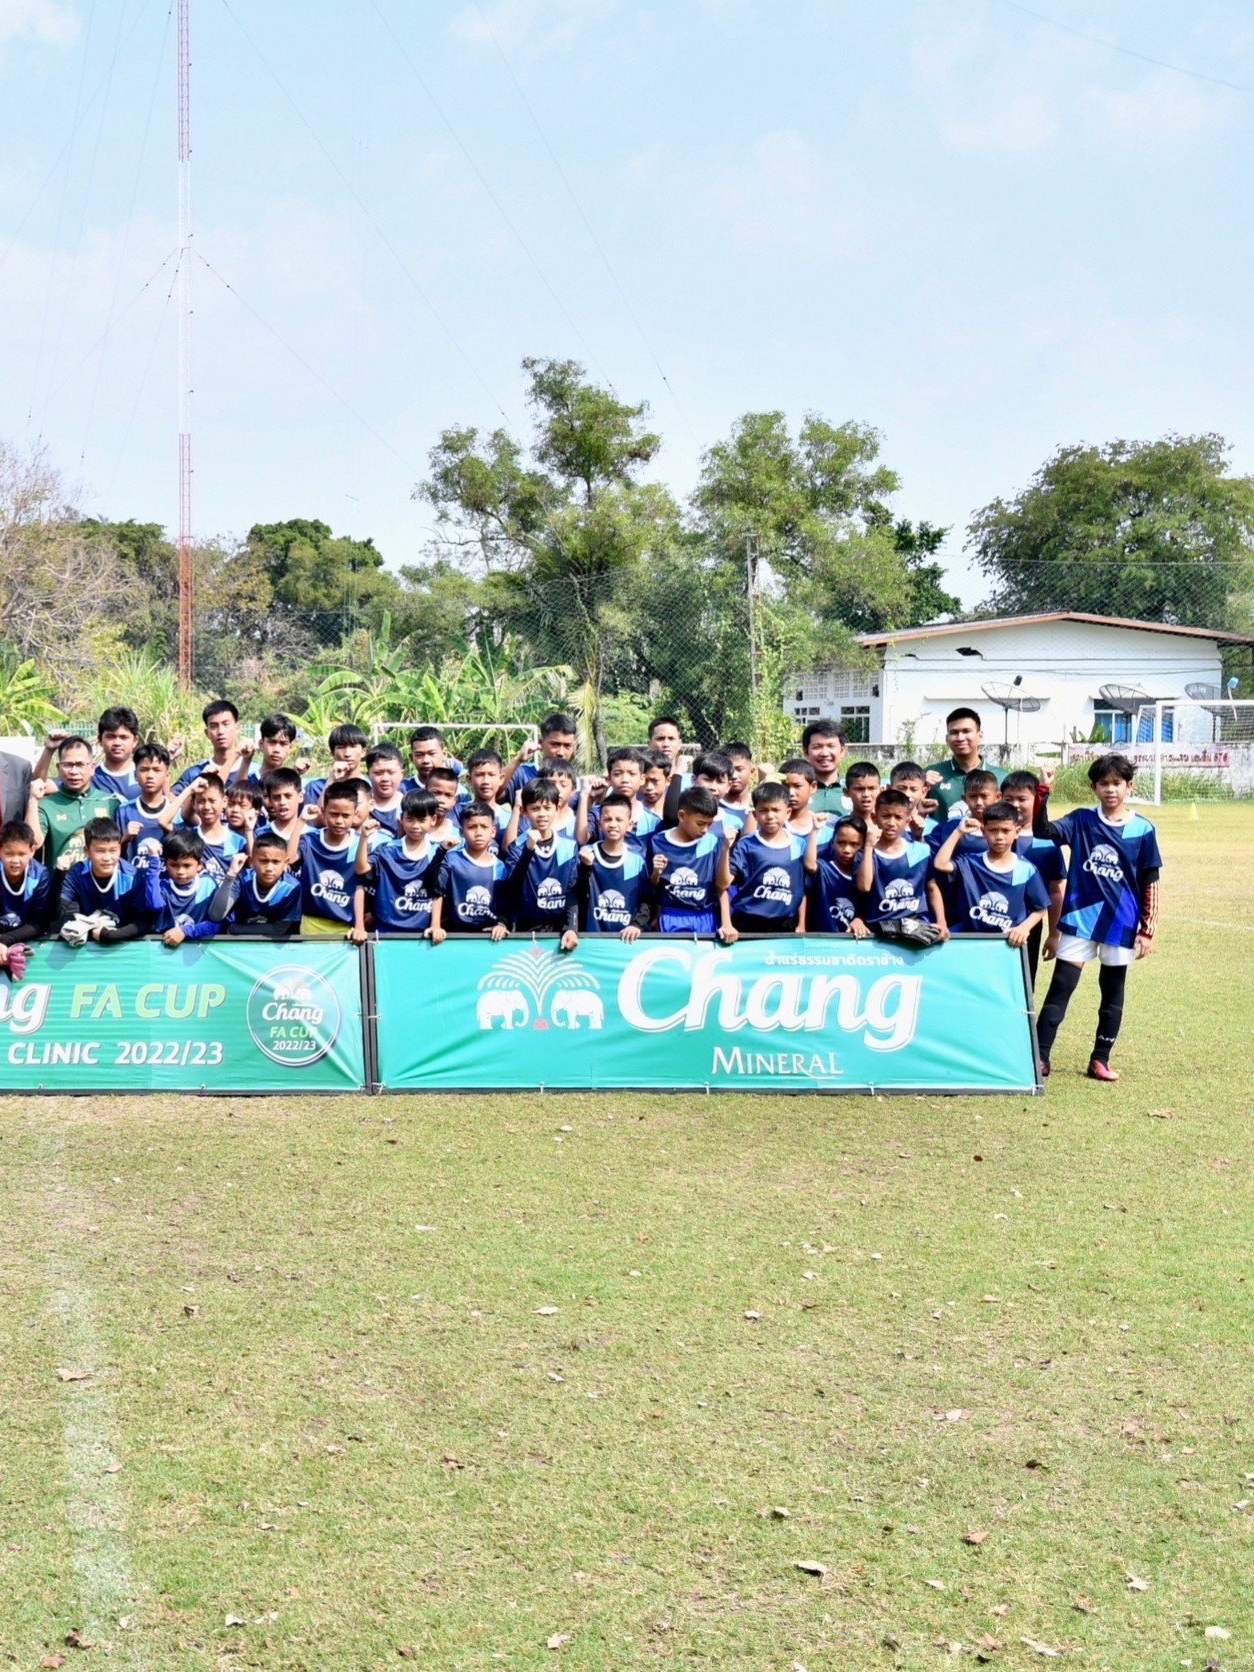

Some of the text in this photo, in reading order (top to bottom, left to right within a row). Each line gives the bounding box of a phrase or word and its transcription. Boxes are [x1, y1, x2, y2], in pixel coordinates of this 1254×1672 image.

[1083, 859, 1124, 882] Chang
[310, 883, 351, 908] Chang
[753, 884, 794, 907] Chang
[878, 898, 920, 912] Chang
[593, 906, 632, 926] Chang
[969, 905, 1014, 933] Chang
[764, 952, 905, 967] น้ำแร่ธรรมชาติตราช้าง
[70, 983, 122, 1018] FA
[135, 983, 226, 1019] CUP
[617, 946, 923, 1053] Chang
[262, 1002, 324, 1025] Chang
[269, 1026, 318, 1039] FA CUP
[7, 1041, 101, 1066] CLINIC
[114, 1040, 224, 1067] 2022/23
[272, 1040, 317, 1051] 2022/23
[711, 1046, 844, 1080] MINERAL
